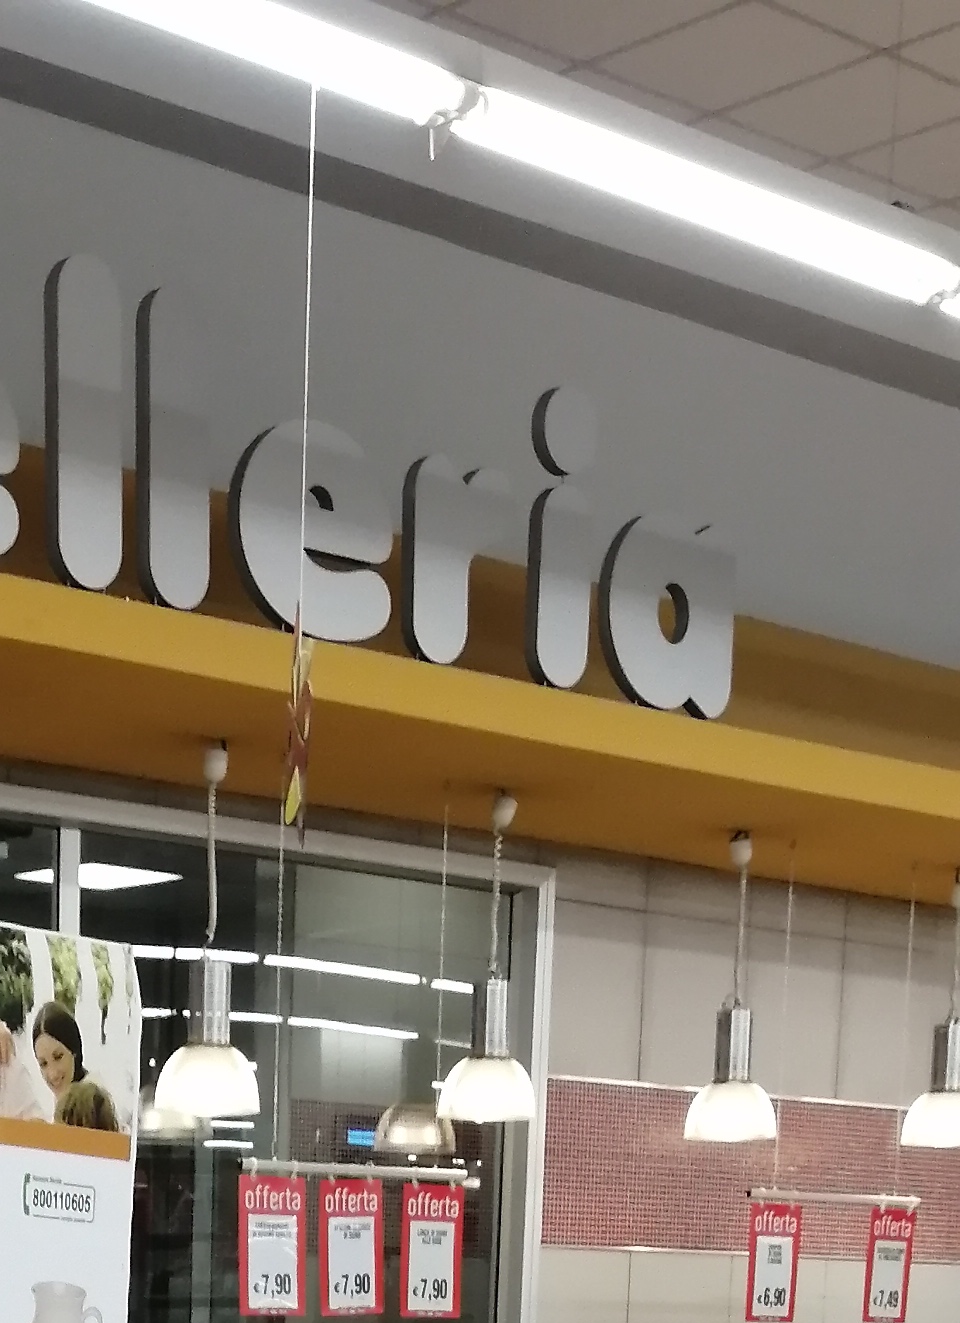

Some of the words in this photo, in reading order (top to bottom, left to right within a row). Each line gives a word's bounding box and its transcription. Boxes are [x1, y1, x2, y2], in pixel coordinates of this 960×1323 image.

[33, 1188, 91, 1213] 800110605
[244, 1183, 301, 1211] offerta
[325, 1188, 378, 1214] offerta
[407, 1191, 459, 1219] offerta
[755, 1211, 798, 1234] offerta
[873, 1215, 912, 1238] offerta
